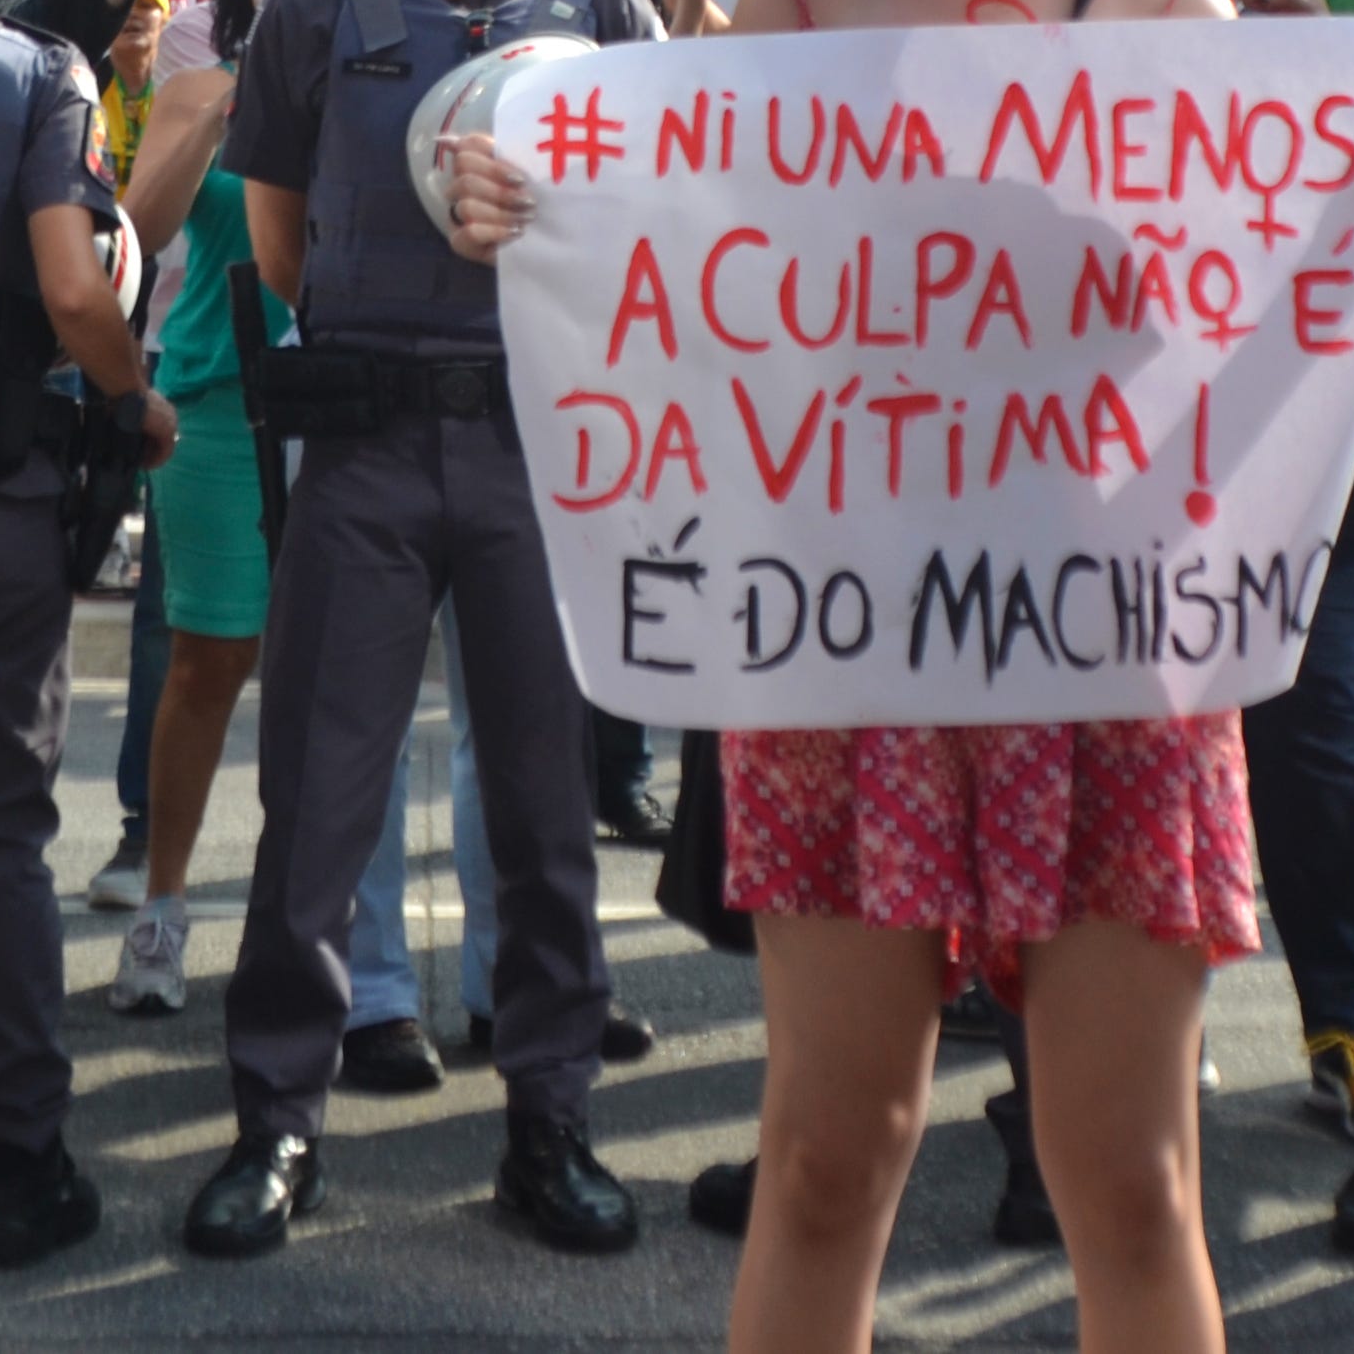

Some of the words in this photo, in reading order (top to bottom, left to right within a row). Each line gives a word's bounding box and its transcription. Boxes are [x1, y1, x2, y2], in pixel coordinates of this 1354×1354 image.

[767, 91, 945, 189] UNA
[606, 235, 678, 369] A
[699, 226, 1034, 354] CULPA
[1070, 221, 1257, 353] NÃO
[551, 388, 709, 514] DA
[622, 516, 707, 674] É
[733, 554, 875, 673] DO
